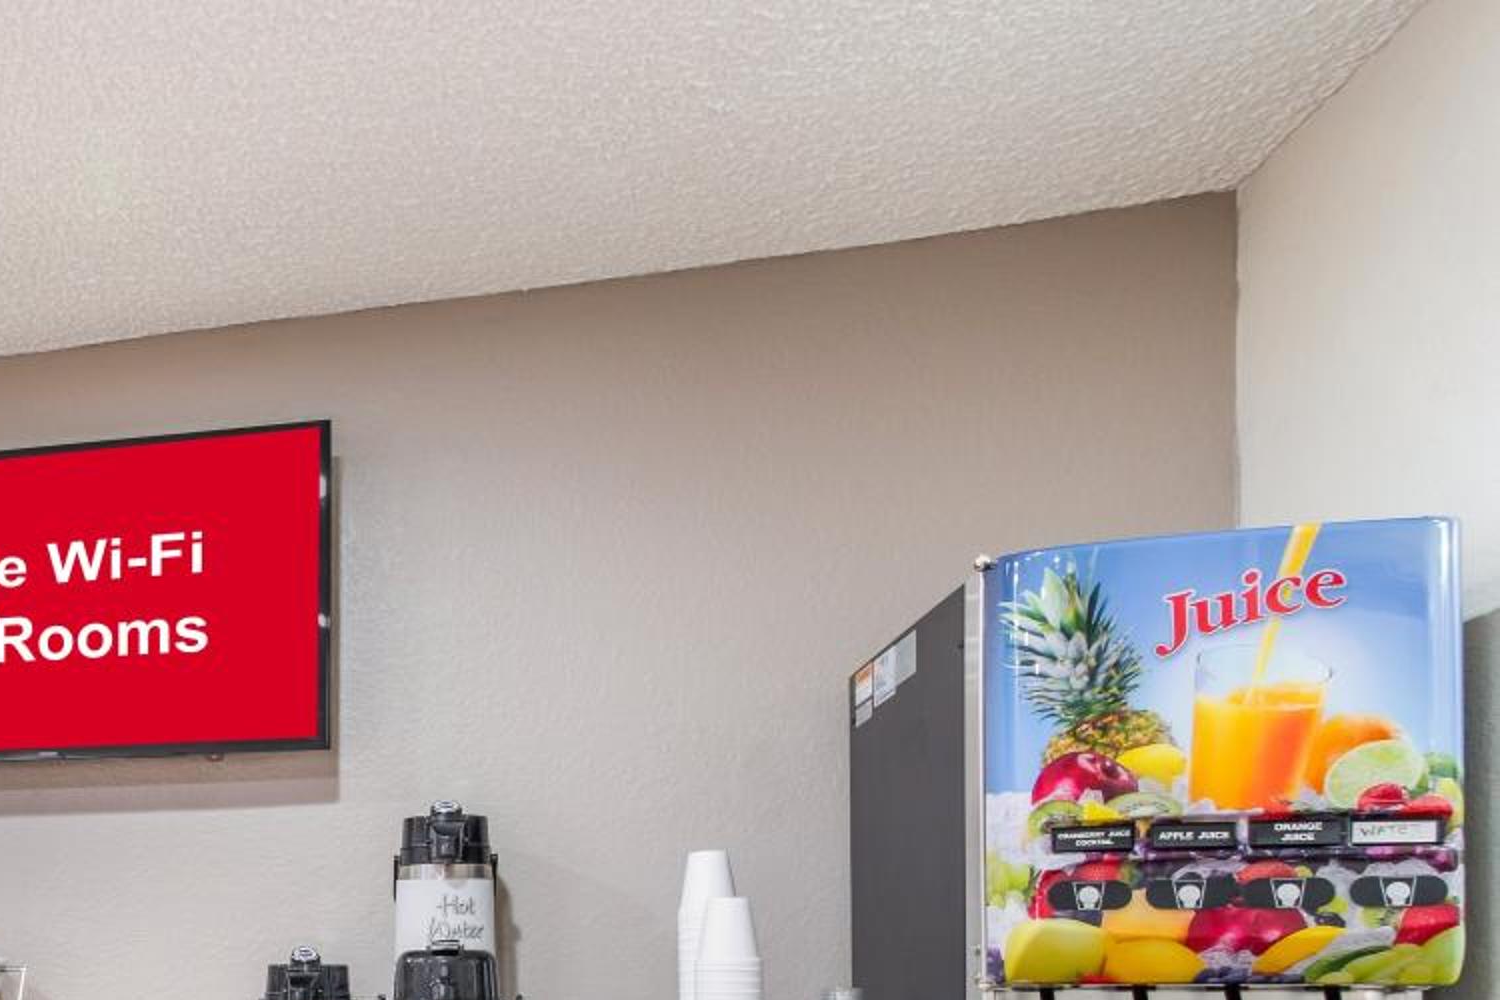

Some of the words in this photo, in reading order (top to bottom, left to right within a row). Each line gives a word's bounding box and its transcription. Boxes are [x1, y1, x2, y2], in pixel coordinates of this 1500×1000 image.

[46, 530, 203, 584] Wi-Fi
[1154, 567, 1349, 658] Juice
[1158, 831, 1194, 841] APPLE
[1197, 831, 1230, 841] JUICE
[1274, 822, 1323, 832] ORANGE
[1281, 832, 1316, 842] JUICE
[435, 894, 477, 918] Hot
[428, 917, 485, 941] Water
